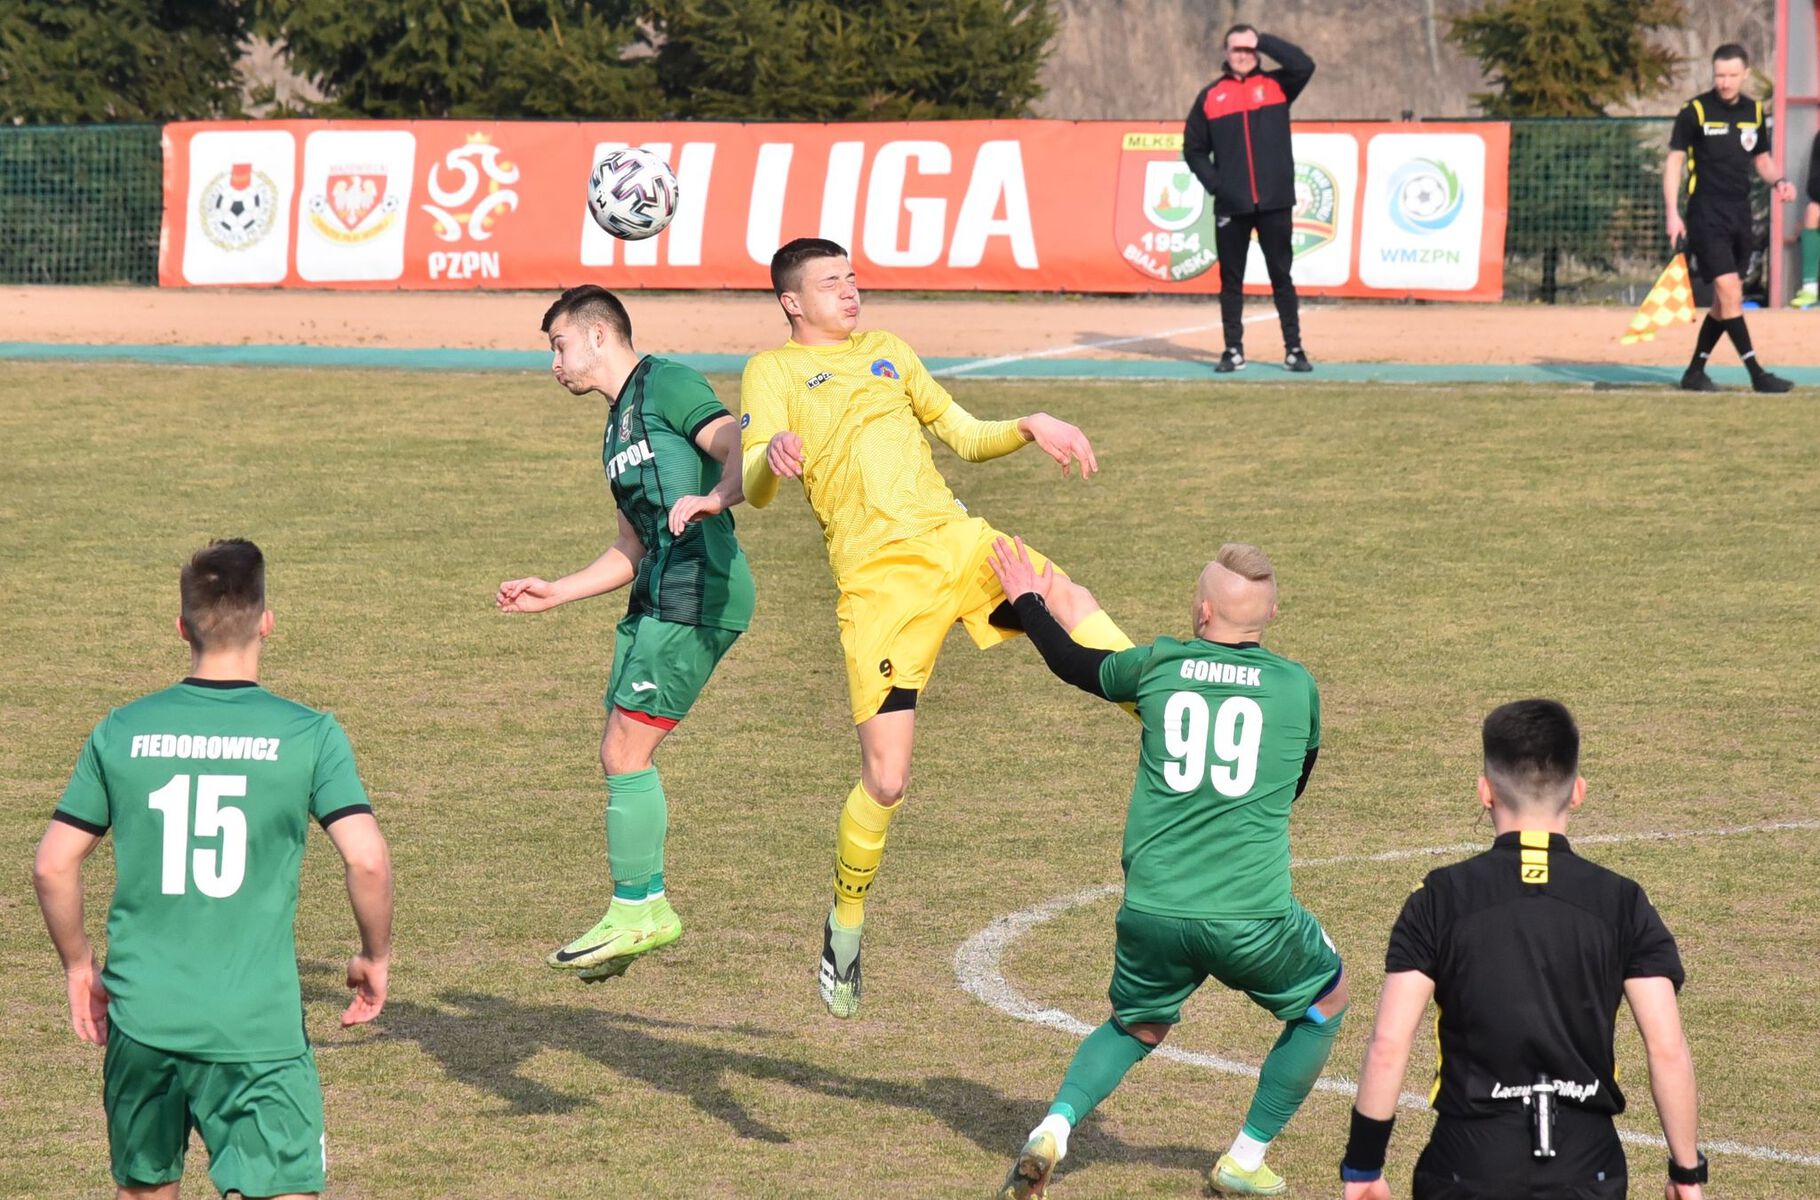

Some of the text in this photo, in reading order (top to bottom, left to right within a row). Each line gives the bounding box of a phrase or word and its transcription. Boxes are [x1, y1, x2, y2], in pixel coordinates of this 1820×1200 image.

[1127, 136, 1175, 148] MLKS
[1140, 232, 1200, 252] 1954
[1380, 247, 1460, 264] WMZPN
[428, 251, 500, 279] PZPN
[1171, 247, 1217, 279] PISKA
[606, 439, 655, 481] TPOL
[879, 658, 892, 678] 9
[1180, 659, 1262, 686] GONDEK
[130, 734, 280, 761] FIEDOROWICZ
[1163, 691, 1263, 797] 99
[148, 774, 247, 898] 15
